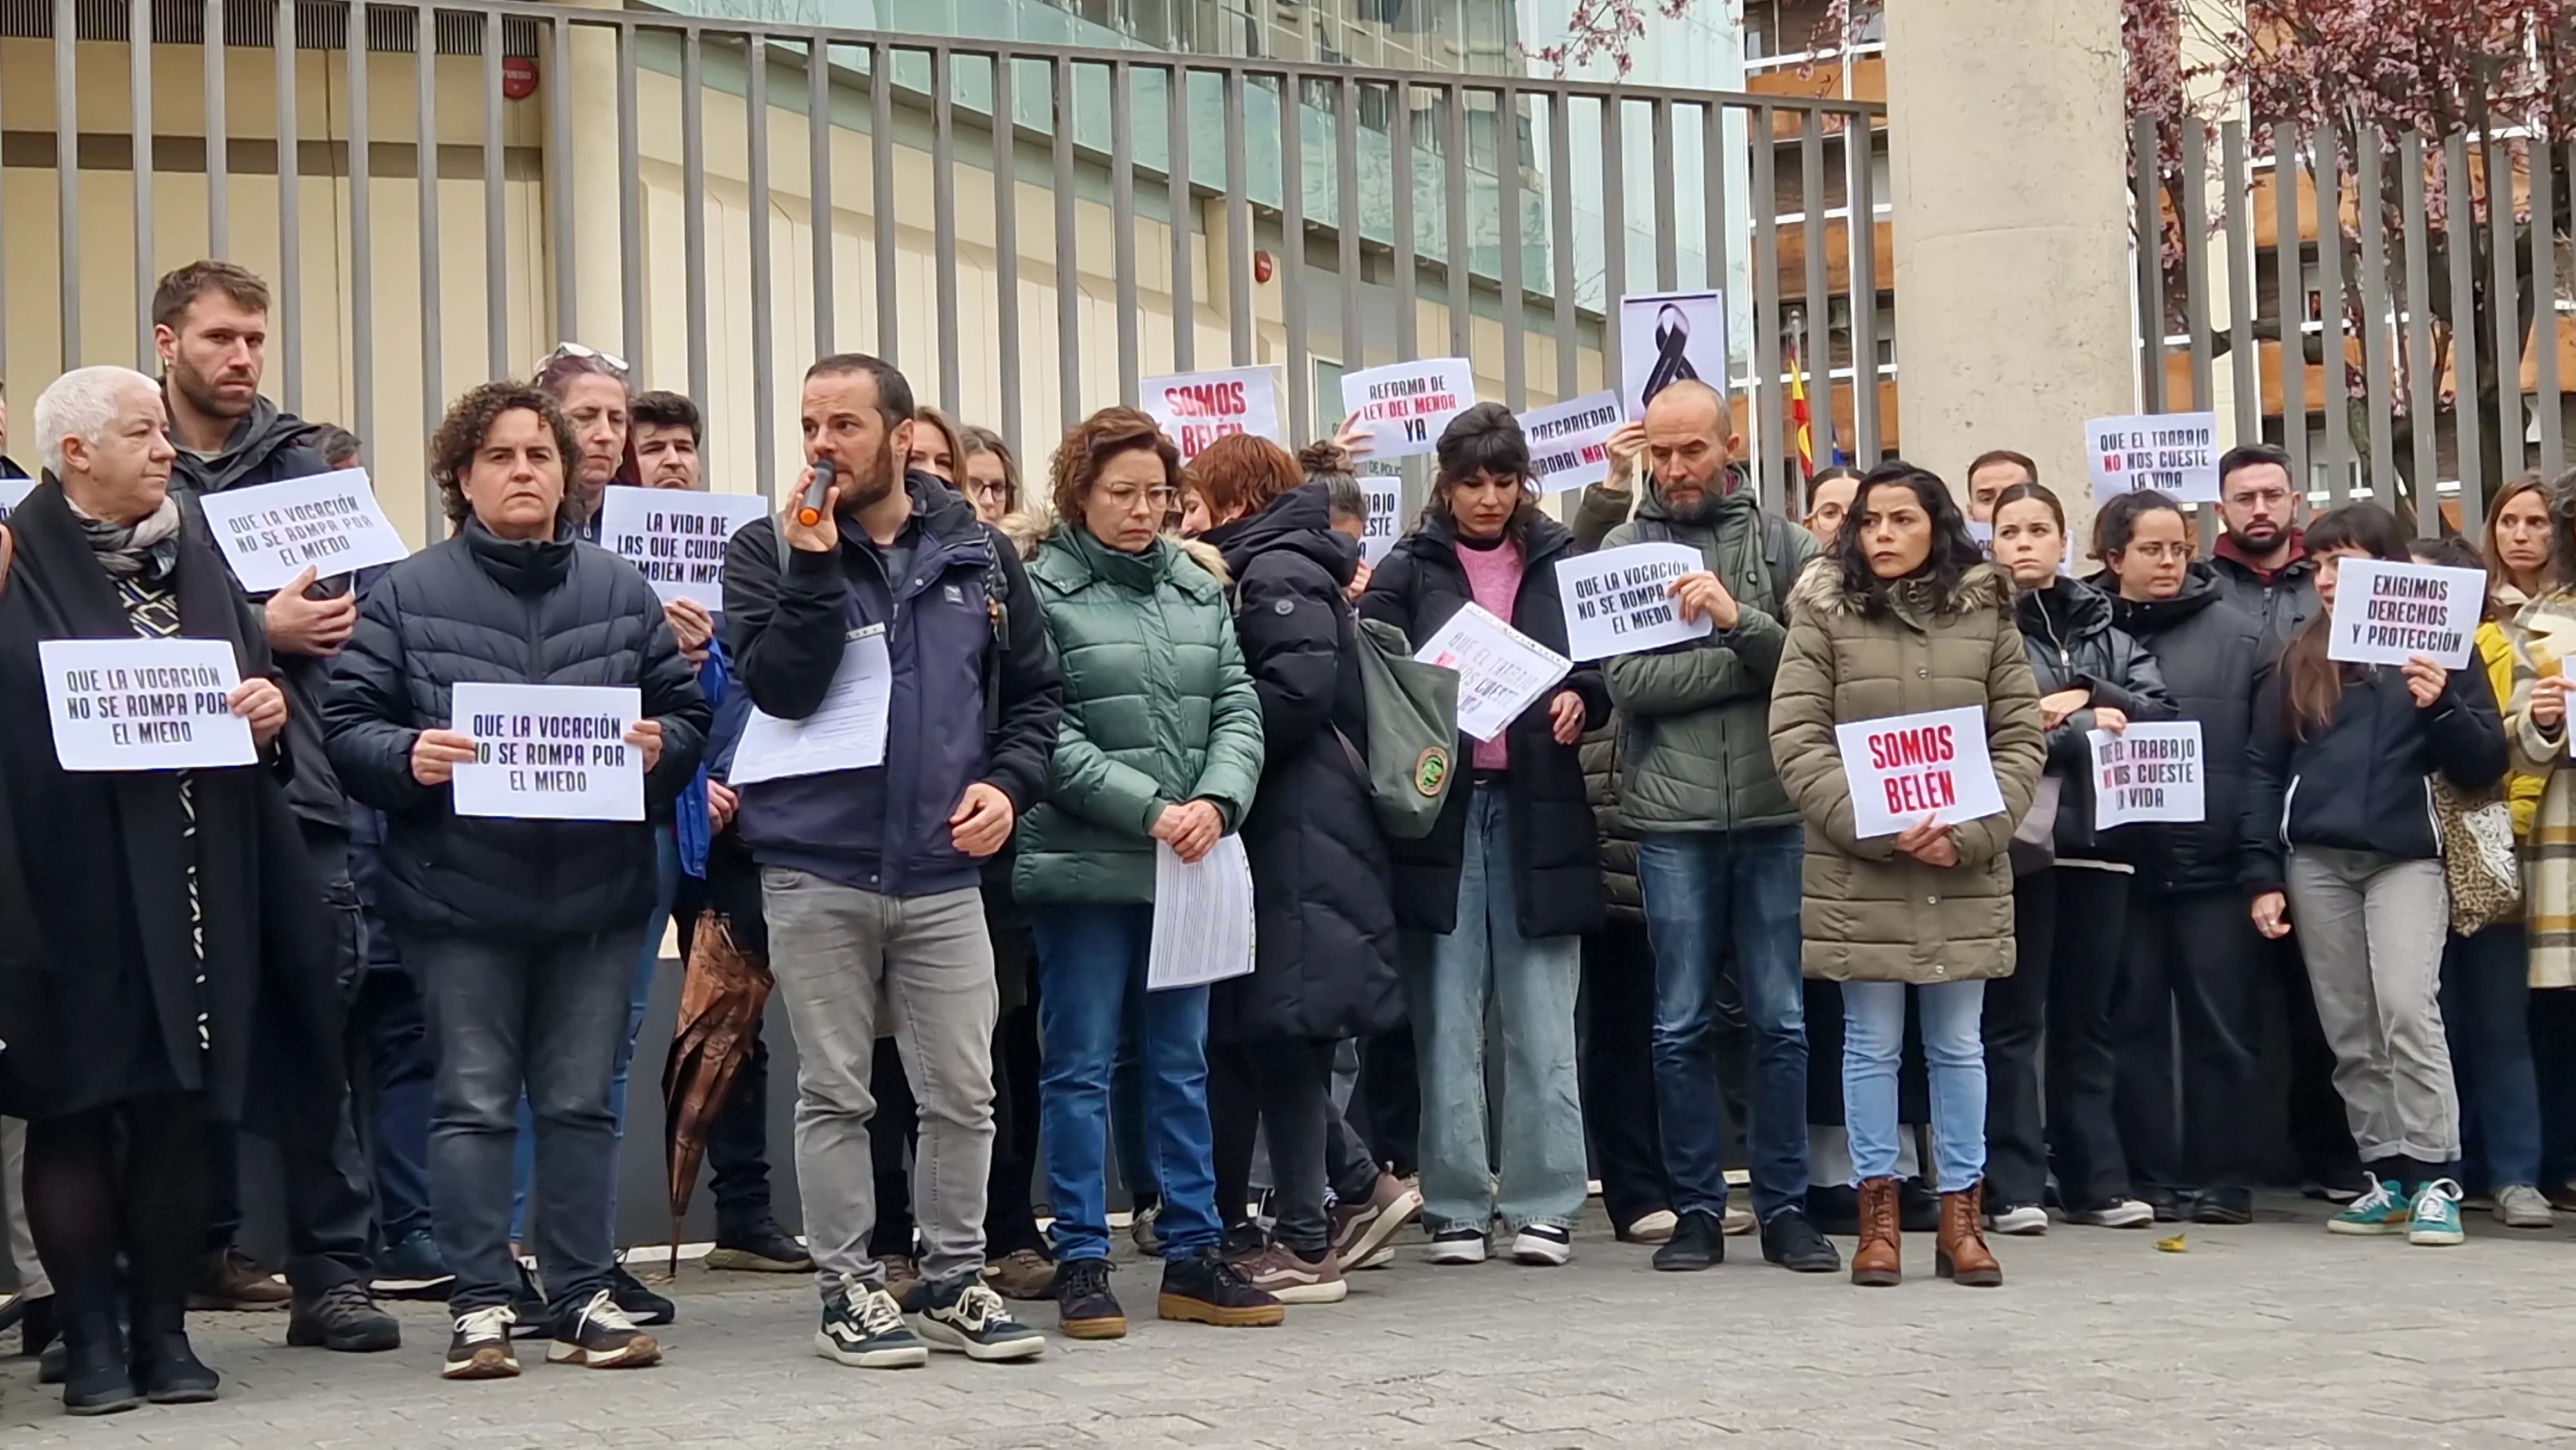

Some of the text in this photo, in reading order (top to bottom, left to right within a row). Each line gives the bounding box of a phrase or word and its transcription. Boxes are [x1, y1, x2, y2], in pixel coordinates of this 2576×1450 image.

[1164, 381, 1247, 417] SOMOS
[1369, 375, 1446, 400] REFORMA DE
[1363, 393, 1457, 420] LEY DEL MENOR
[1404, 418, 1428, 442] YA
[1531, 406, 1616, 444] PRECARIEDAD
[2100, 428, 2209, 451] QUE EL TRABAJO
[2104, 450, 2208, 473] NO NOS CUESTE
[2130, 471, 2182, 491] LA VIDA
[228, 494, 359, 534] QUE LA VOCACIÓN
[647, 512, 728, 536] LA VIDA DE
[235, 515, 374, 554] NO SE ROMPA POR
[618, 535, 643, 556] LAS
[650, 537, 677, 558] QUE
[279, 535, 350, 567] EL MIEDO
[1575, 559, 1690, 599] QUE LA VOCACIÓN
[2373, 574, 2448, 601] EXIGIMOS
[1578, 583, 1665, 620] NO SE ROMPA
[2367, 600, 2448, 627] DERECHOS
[1612, 605, 1672, 635] EL MIEDO
[2353, 623, 2463, 653] Y PROTECCIÓN
[66, 663, 222, 693] QUE LA VOCACIÓN
[67, 692, 229, 720] NO SE ROMPA POR
[113, 721, 193, 745] EL MIEDO
[473, 713, 620, 740] QUE LA VOCACIÓN
[499, 742, 519, 765] SE
[527, 743, 585, 766] ROMPA
[593, 745, 625, 767] POR
[1868, 725, 1954, 769] SOMOS
[2130, 739, 2195, 761] TRABAJO
[510, 771, 587, 792] EL MIEDO
[2137, 763, 2193, 783] CUESTE
[1884, 766, 1956, 814] BELÉN
[2129, 787, 2164, 808] VIDA
